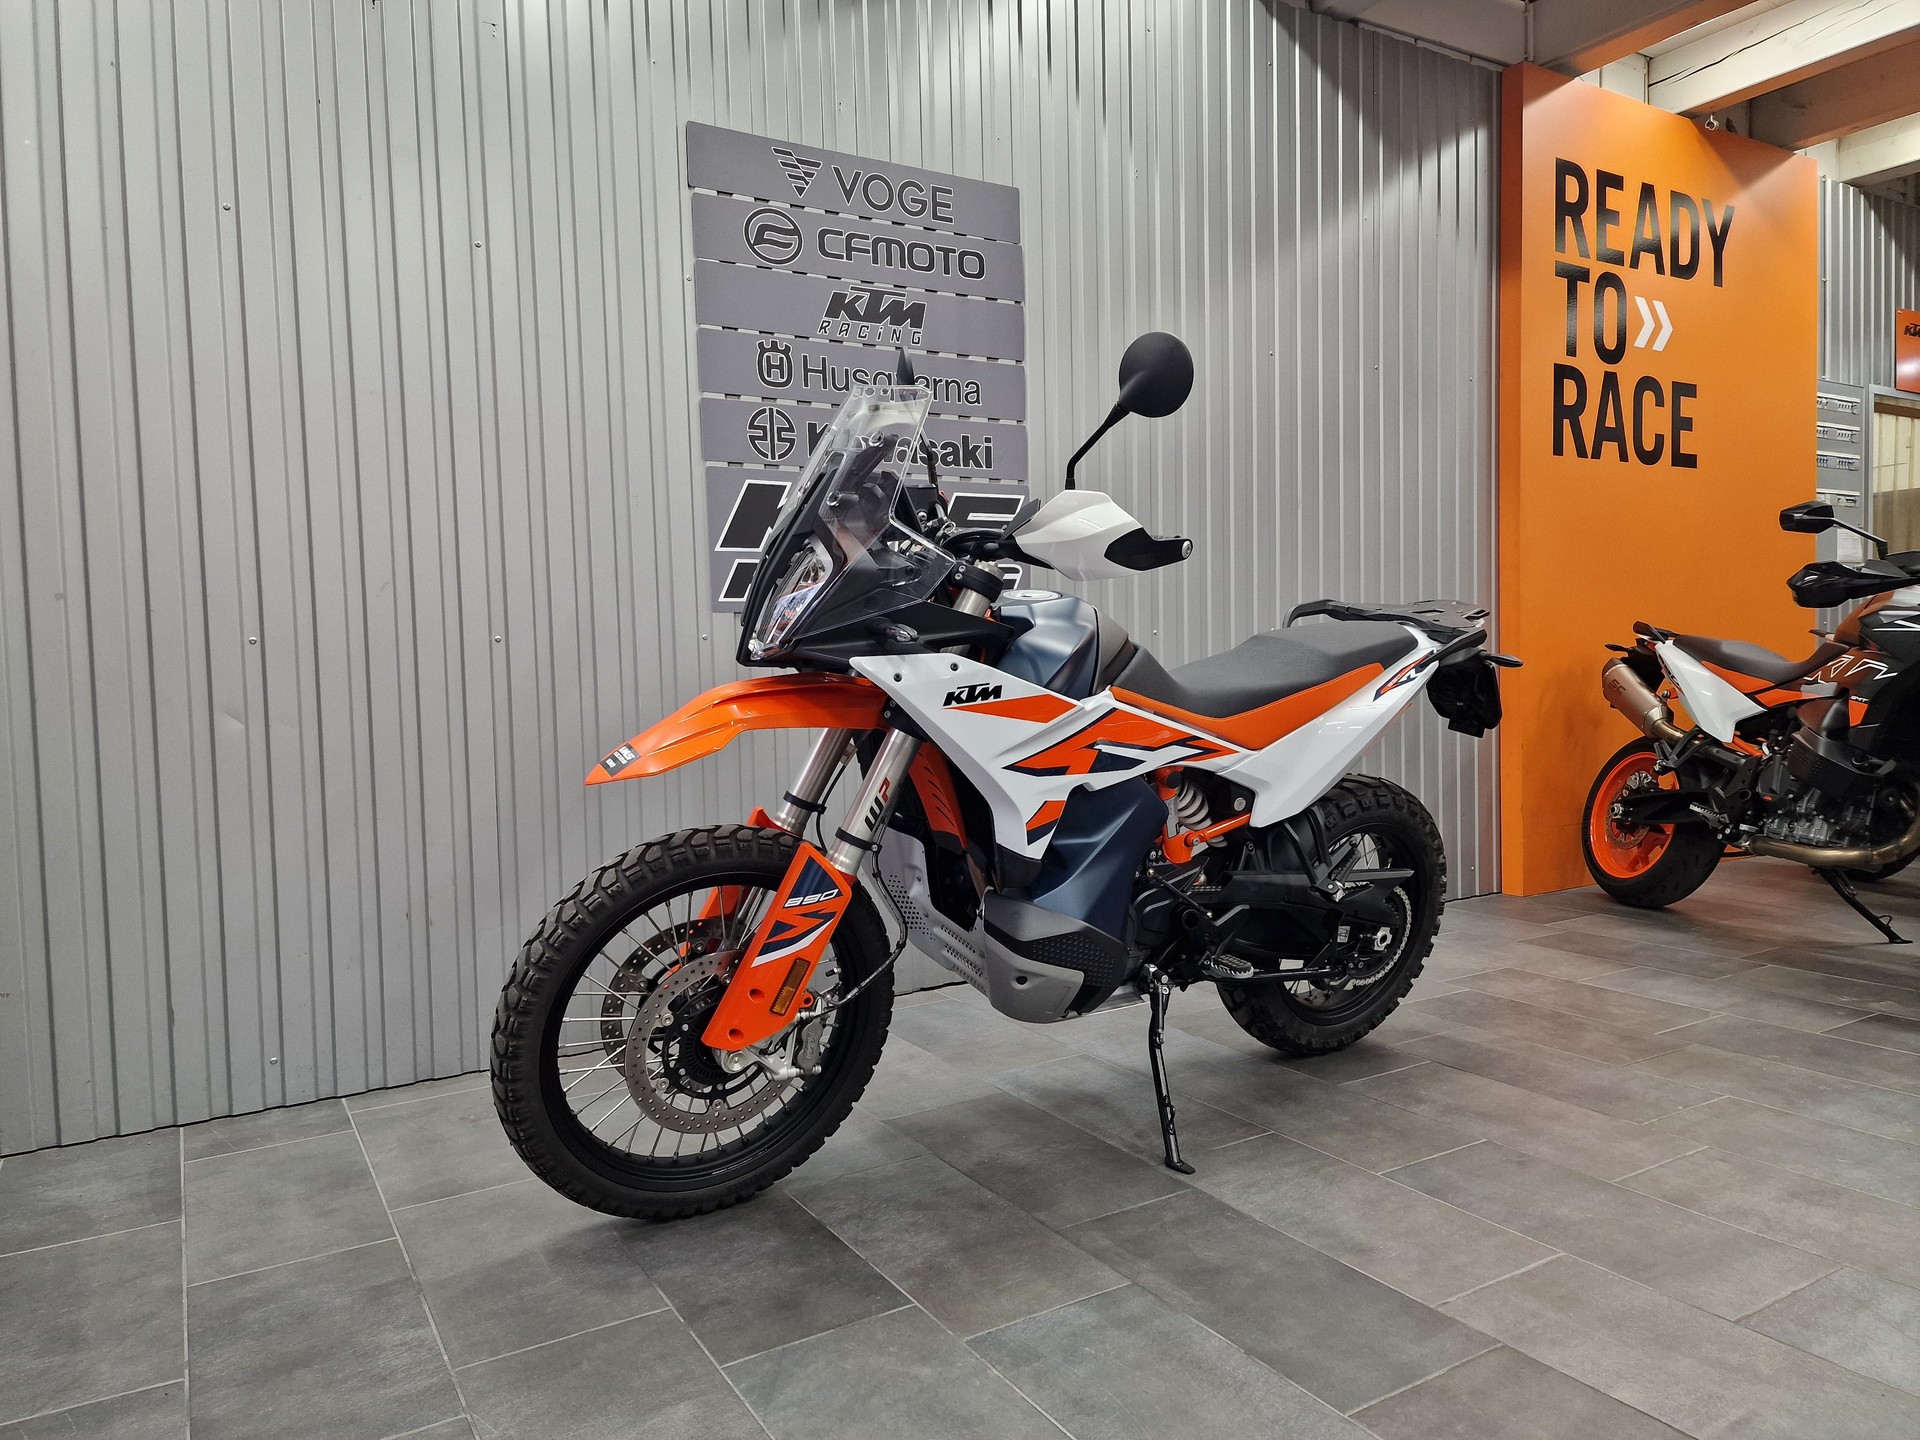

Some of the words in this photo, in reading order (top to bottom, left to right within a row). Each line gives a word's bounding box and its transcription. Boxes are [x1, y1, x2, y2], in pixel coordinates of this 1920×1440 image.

[832, 165, 954, 224] VOGE
[1554, 157, 1735, 288] READY
[817, 227, 986, 280] CFMOTO
[823, 285, 927, 329] KTM
[1554, 260, 1627, 365] TO
[1904, 322, 1920, 337] KT
[802, 354, 982, 405] Husqarna
[1552, 363, 1698, 469] RACE
[943, 683, 1002, 706] KTM
[864, 776, 891, 833] WP
[784, 888, 840, 908] 890
